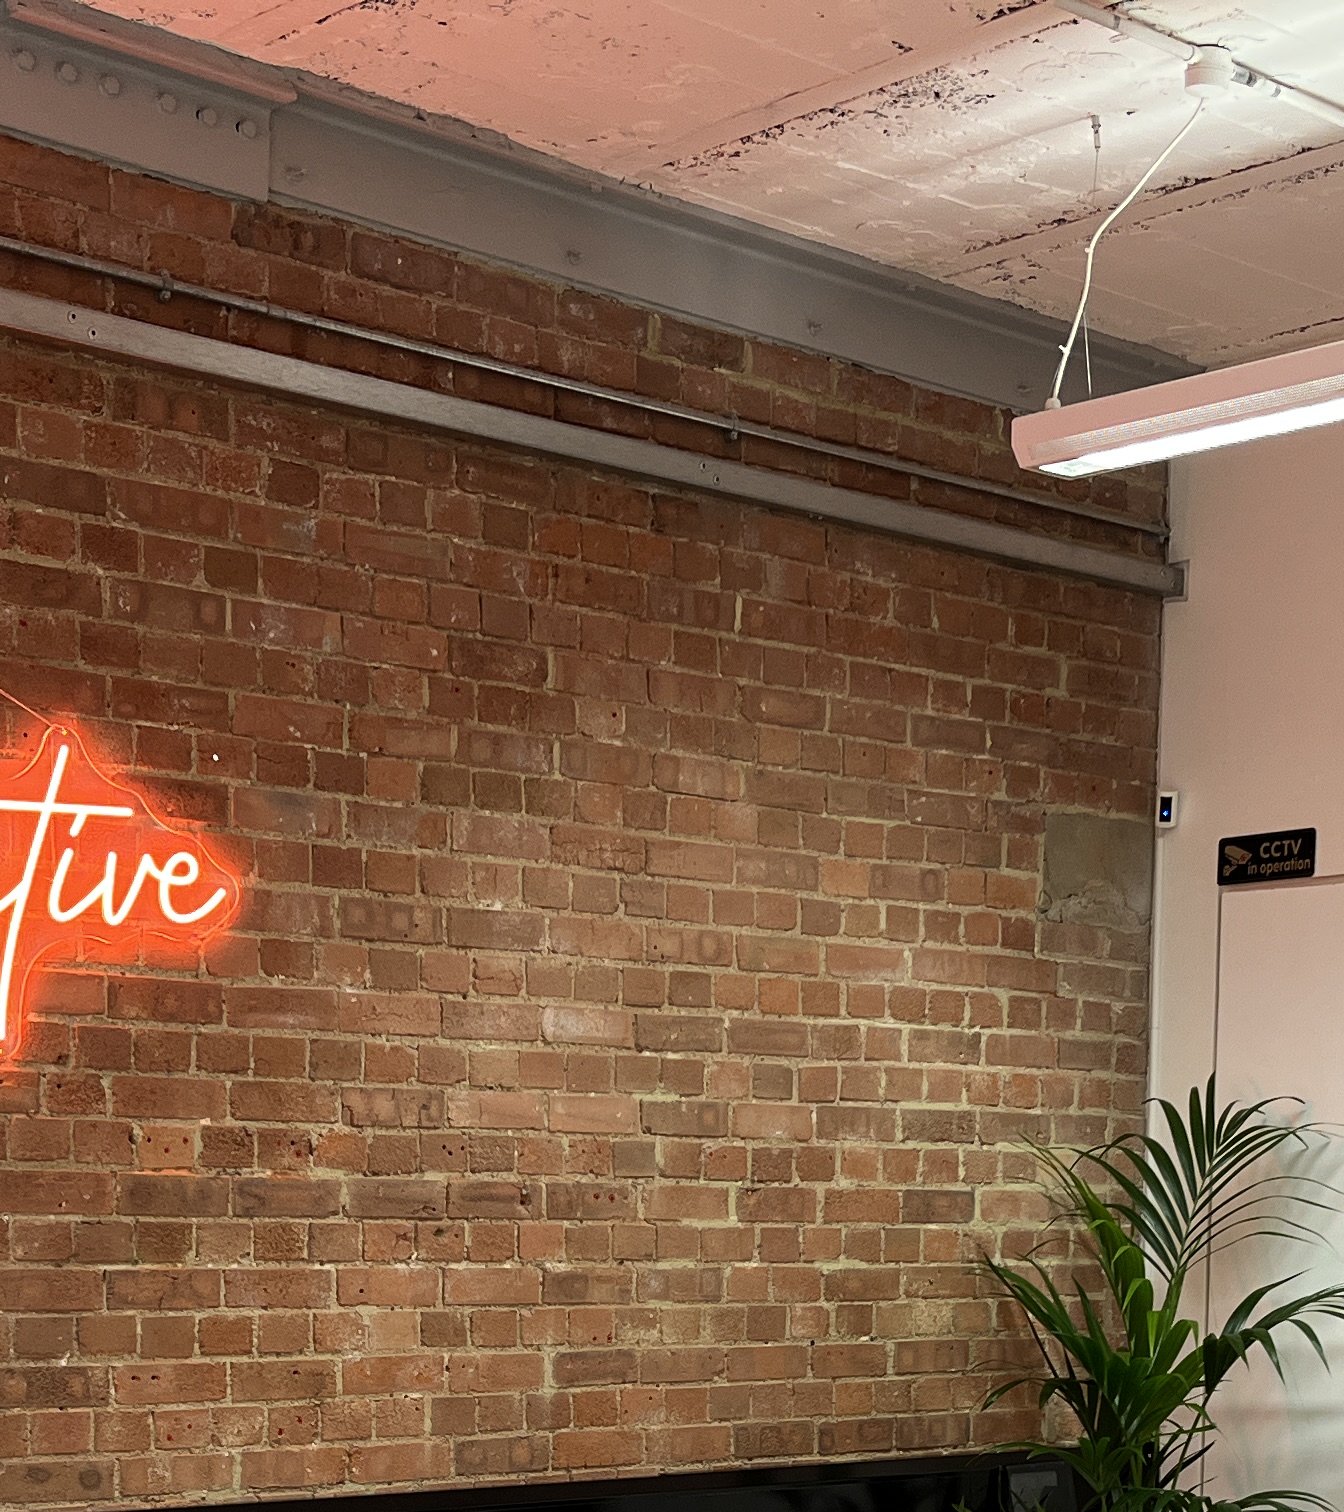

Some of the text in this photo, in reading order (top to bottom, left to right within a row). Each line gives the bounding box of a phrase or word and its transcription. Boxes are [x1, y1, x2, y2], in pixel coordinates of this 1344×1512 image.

[1260, 839, 1303, 858] CCTV
[1247, 857, 1311, 876] in operation
